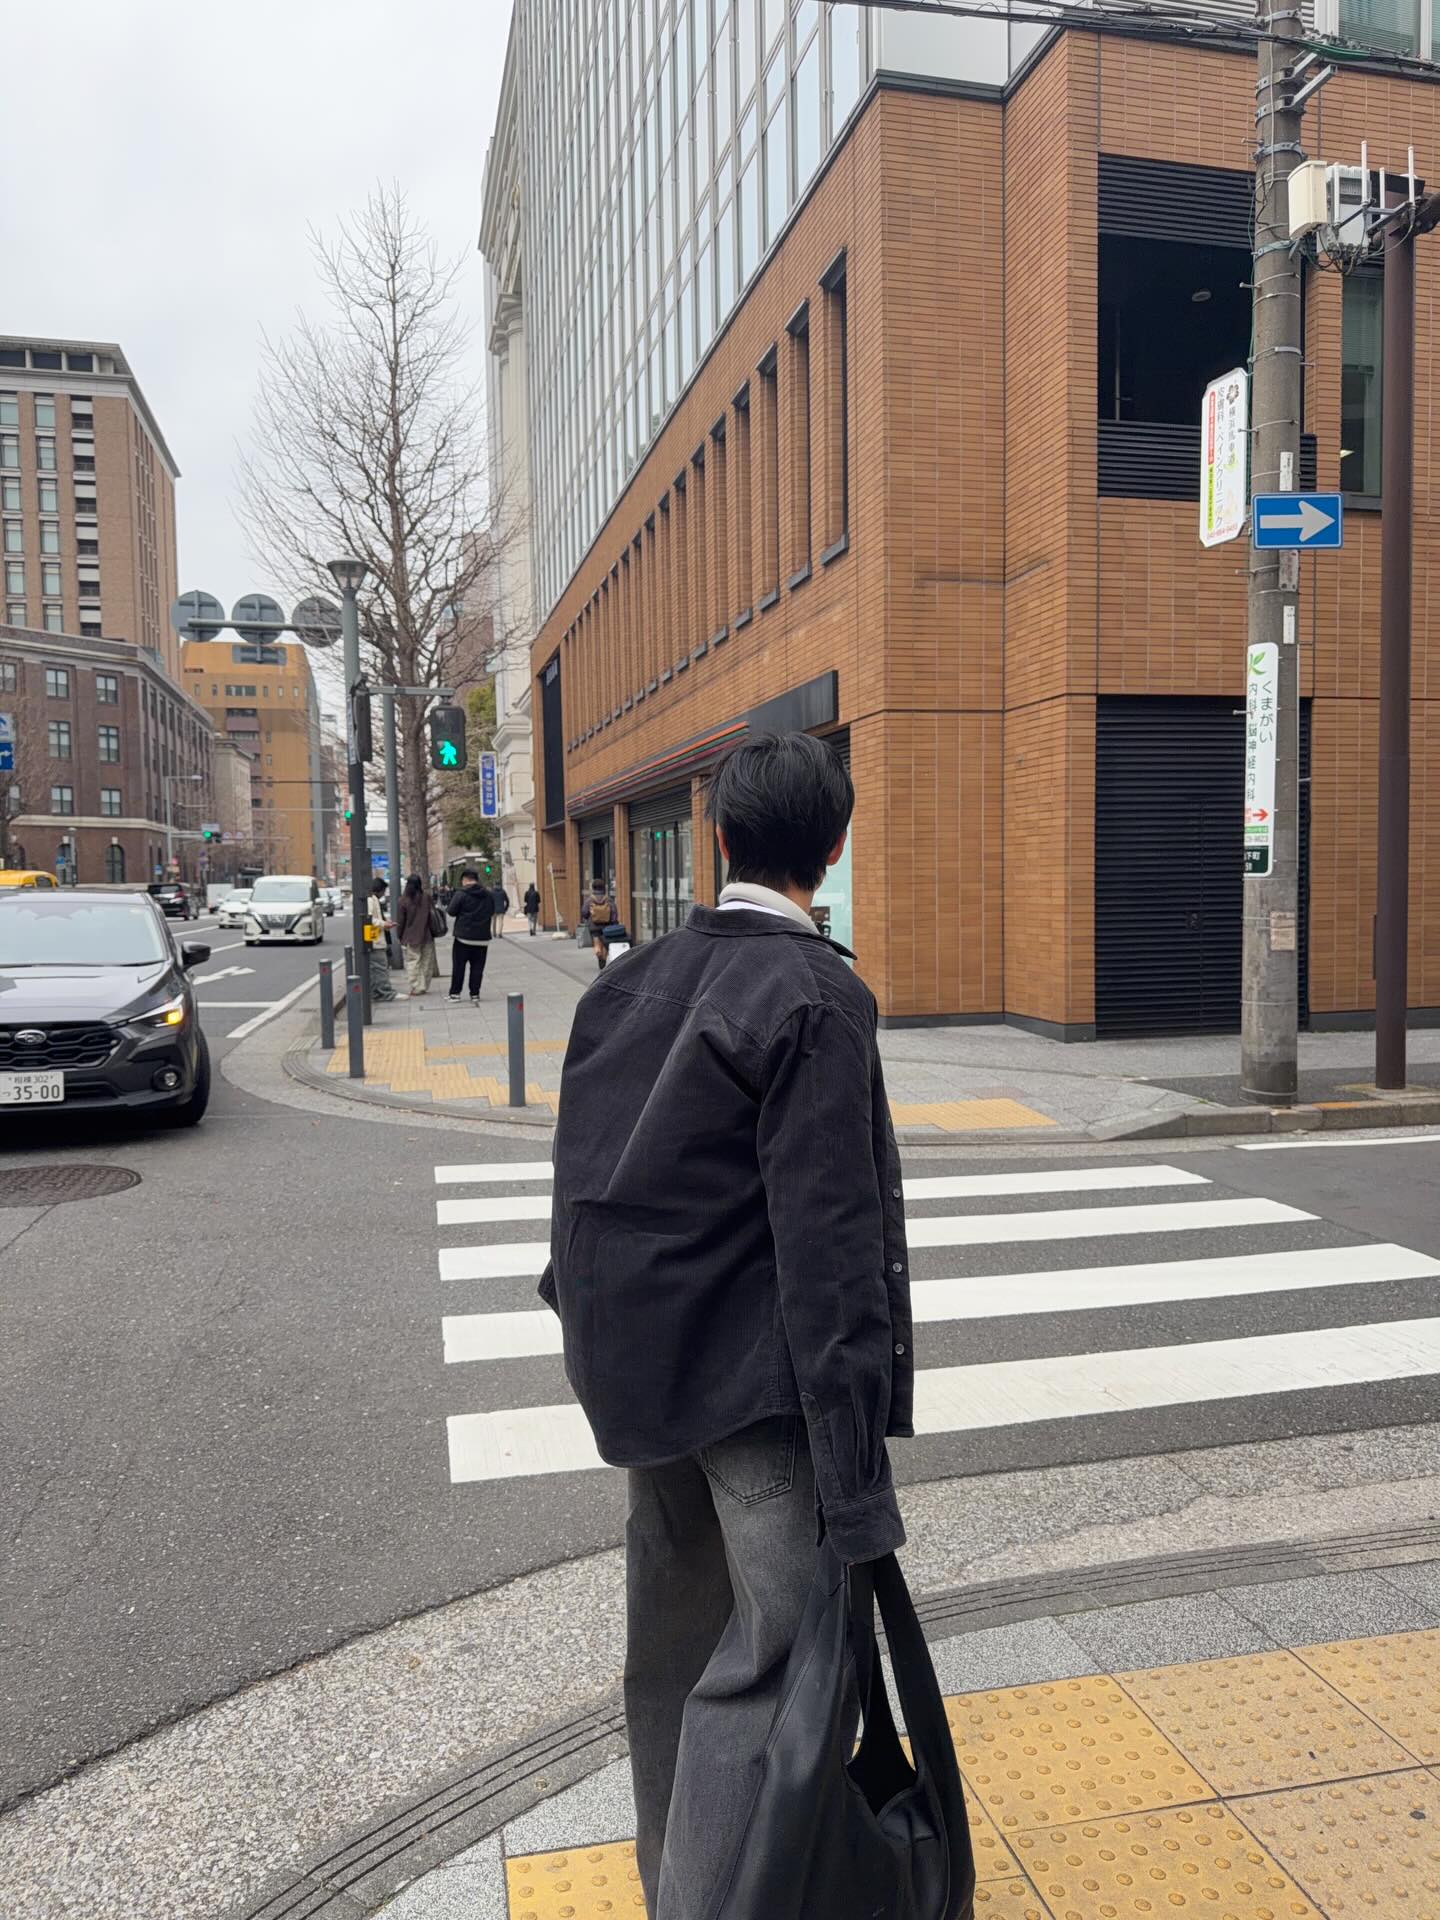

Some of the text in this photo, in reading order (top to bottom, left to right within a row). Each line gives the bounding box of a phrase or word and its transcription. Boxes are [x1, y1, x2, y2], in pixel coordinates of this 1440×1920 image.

[1259, 680, 1274, 744] くまがい
[33, 1075, 49, 1083] 302
[13, 1084, 60, 1100] 35-00
